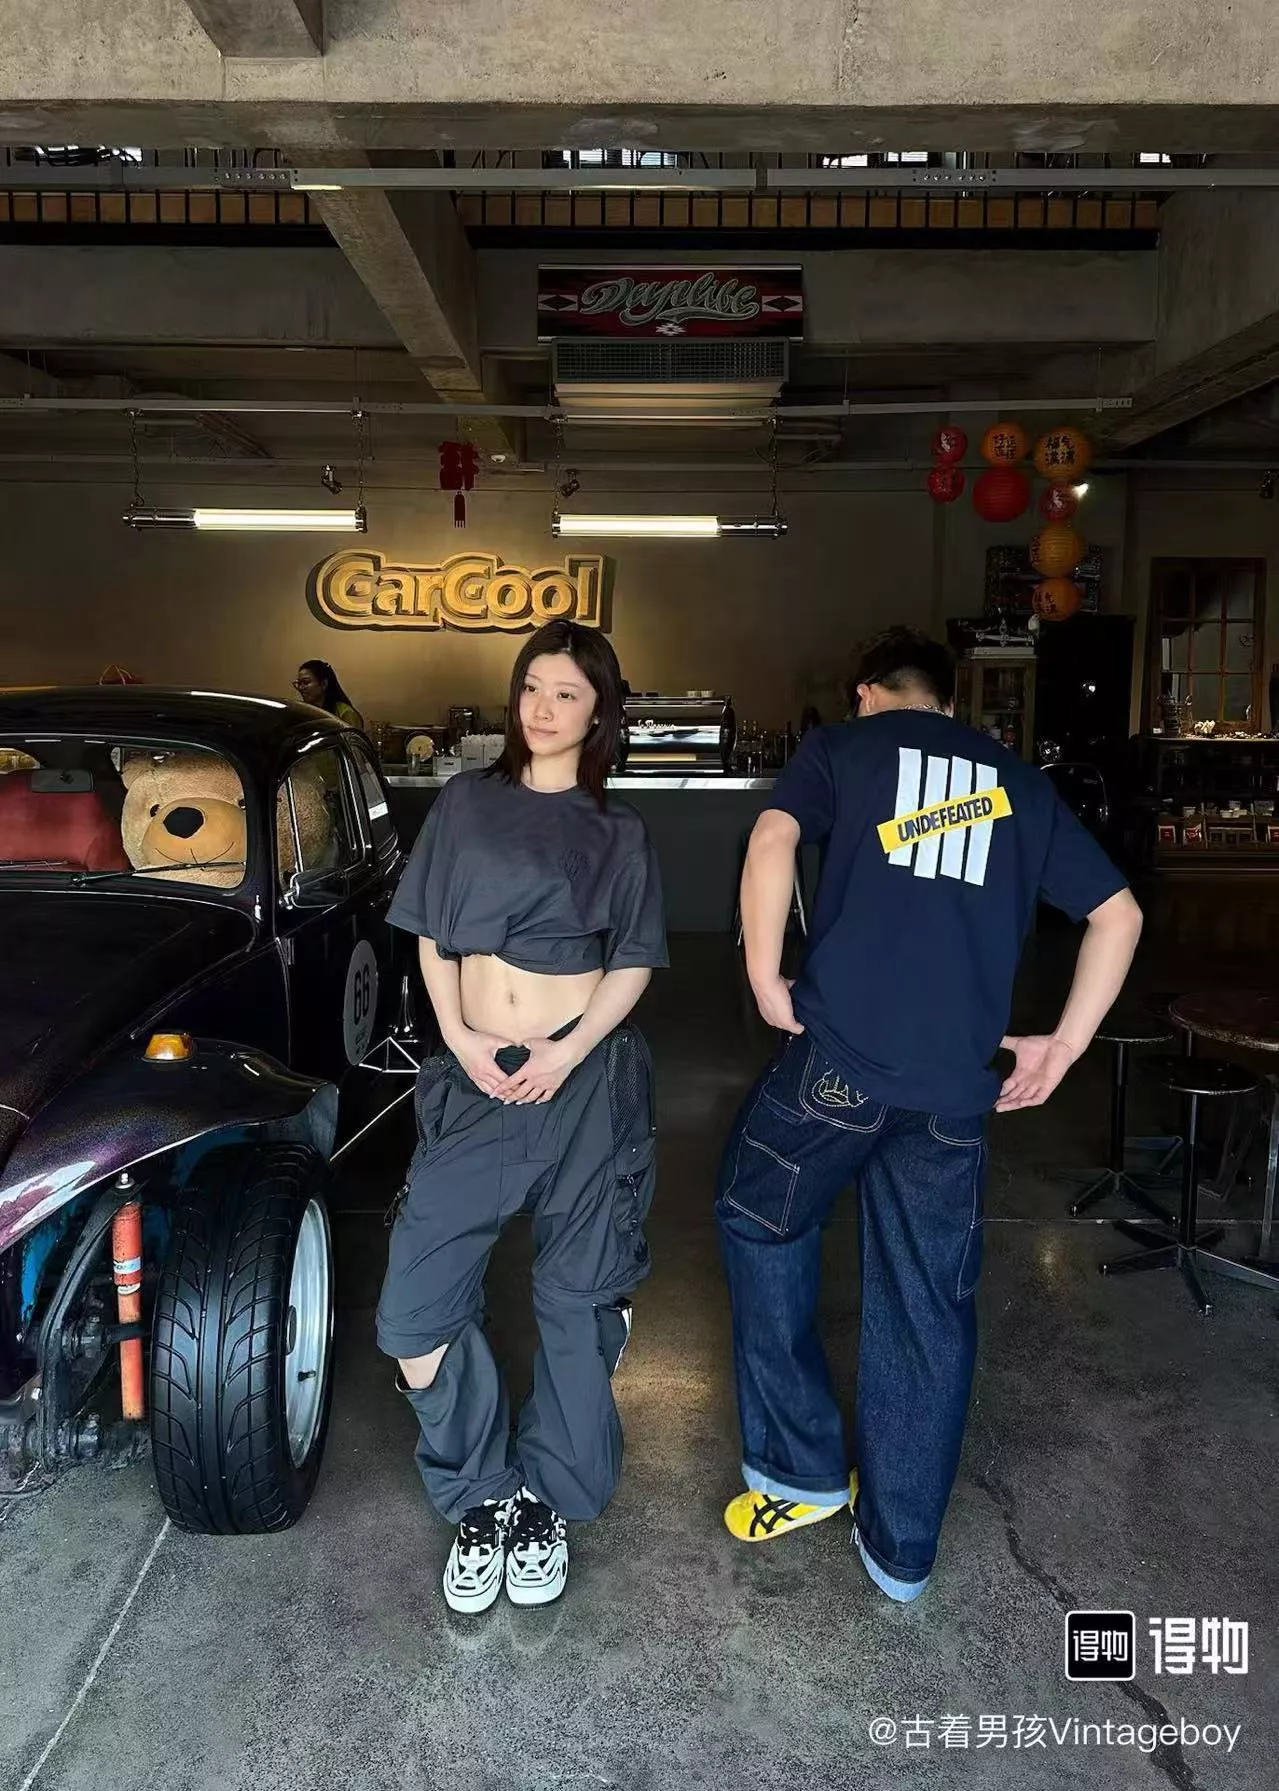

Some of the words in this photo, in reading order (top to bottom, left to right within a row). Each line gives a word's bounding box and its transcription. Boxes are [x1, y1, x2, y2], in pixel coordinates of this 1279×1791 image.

[324, 556, 599, 620] CarCool
[897, 796, 993, 842] UNDEFEATED
[354, 963, 370, 1025] 66
